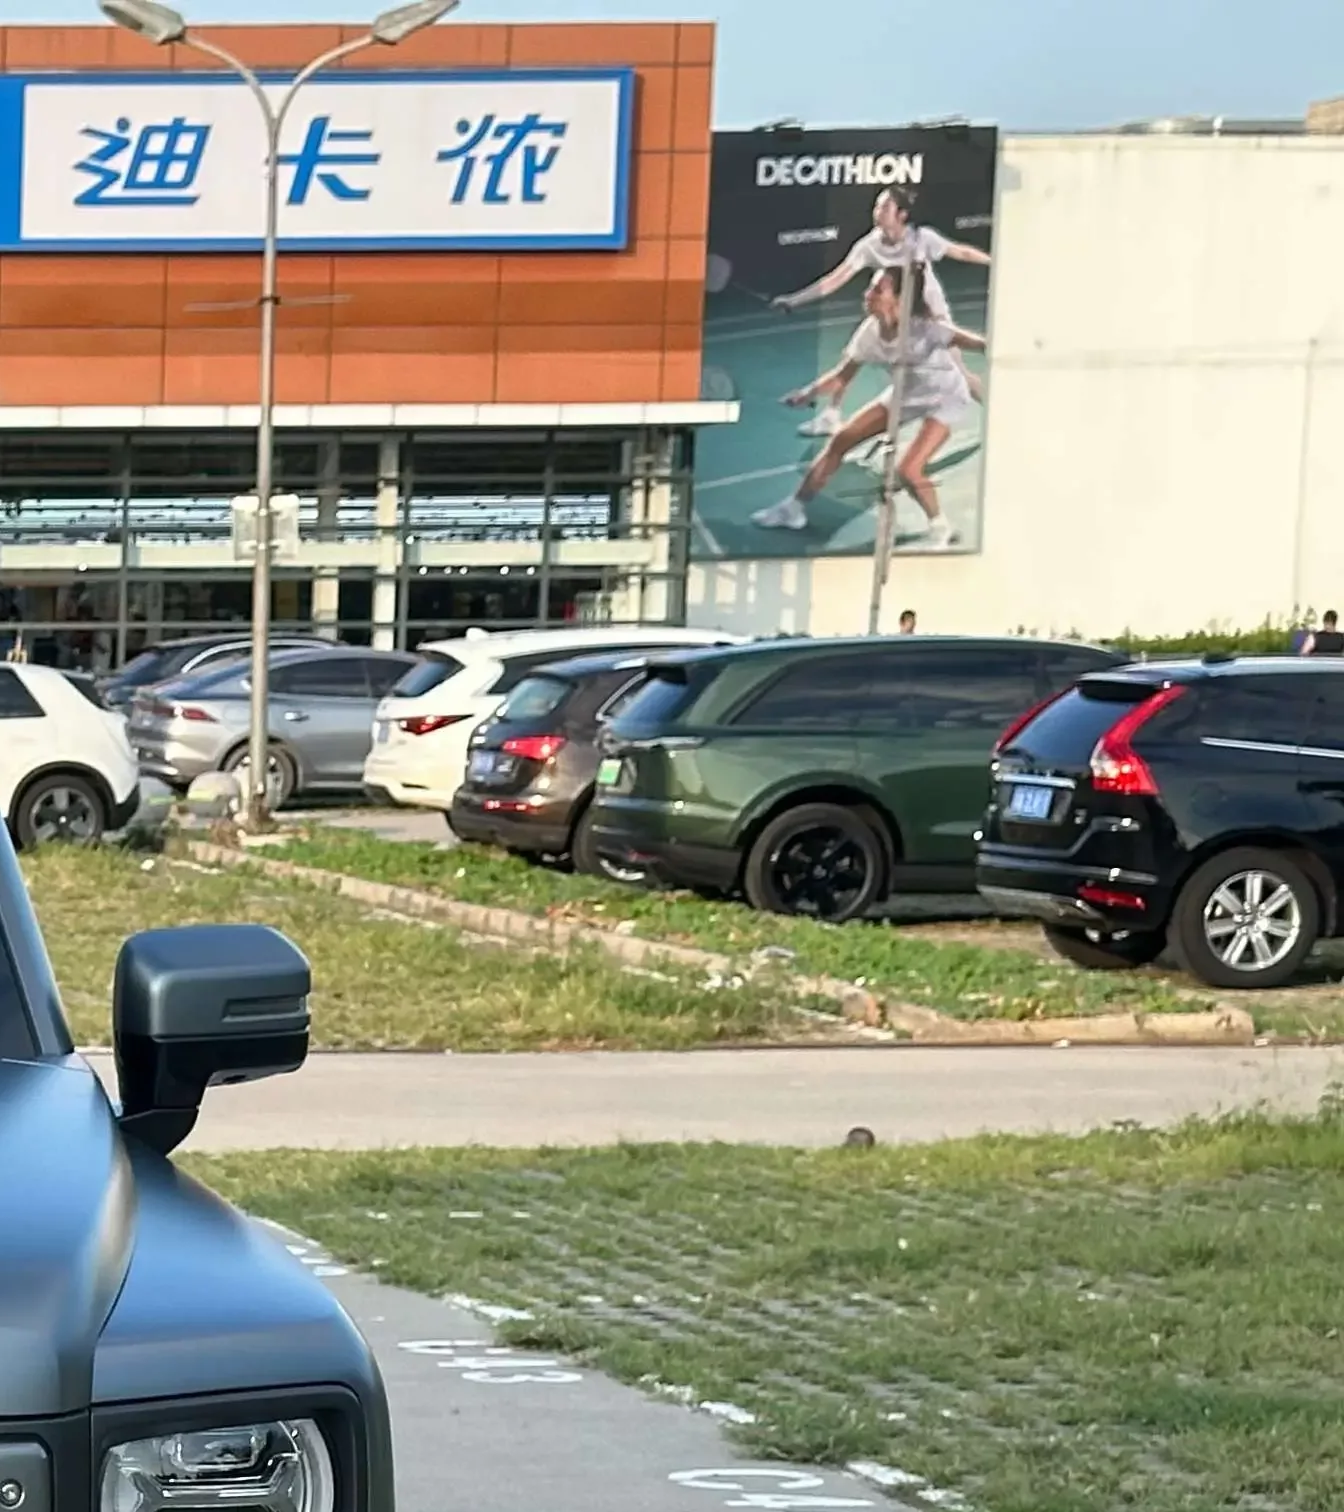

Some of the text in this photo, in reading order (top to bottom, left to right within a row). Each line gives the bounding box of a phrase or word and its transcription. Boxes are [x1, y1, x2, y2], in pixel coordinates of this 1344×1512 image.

[72, 113, 568, 207] 迪卡侬
[755, 153, 925, 187] DECATHLON
